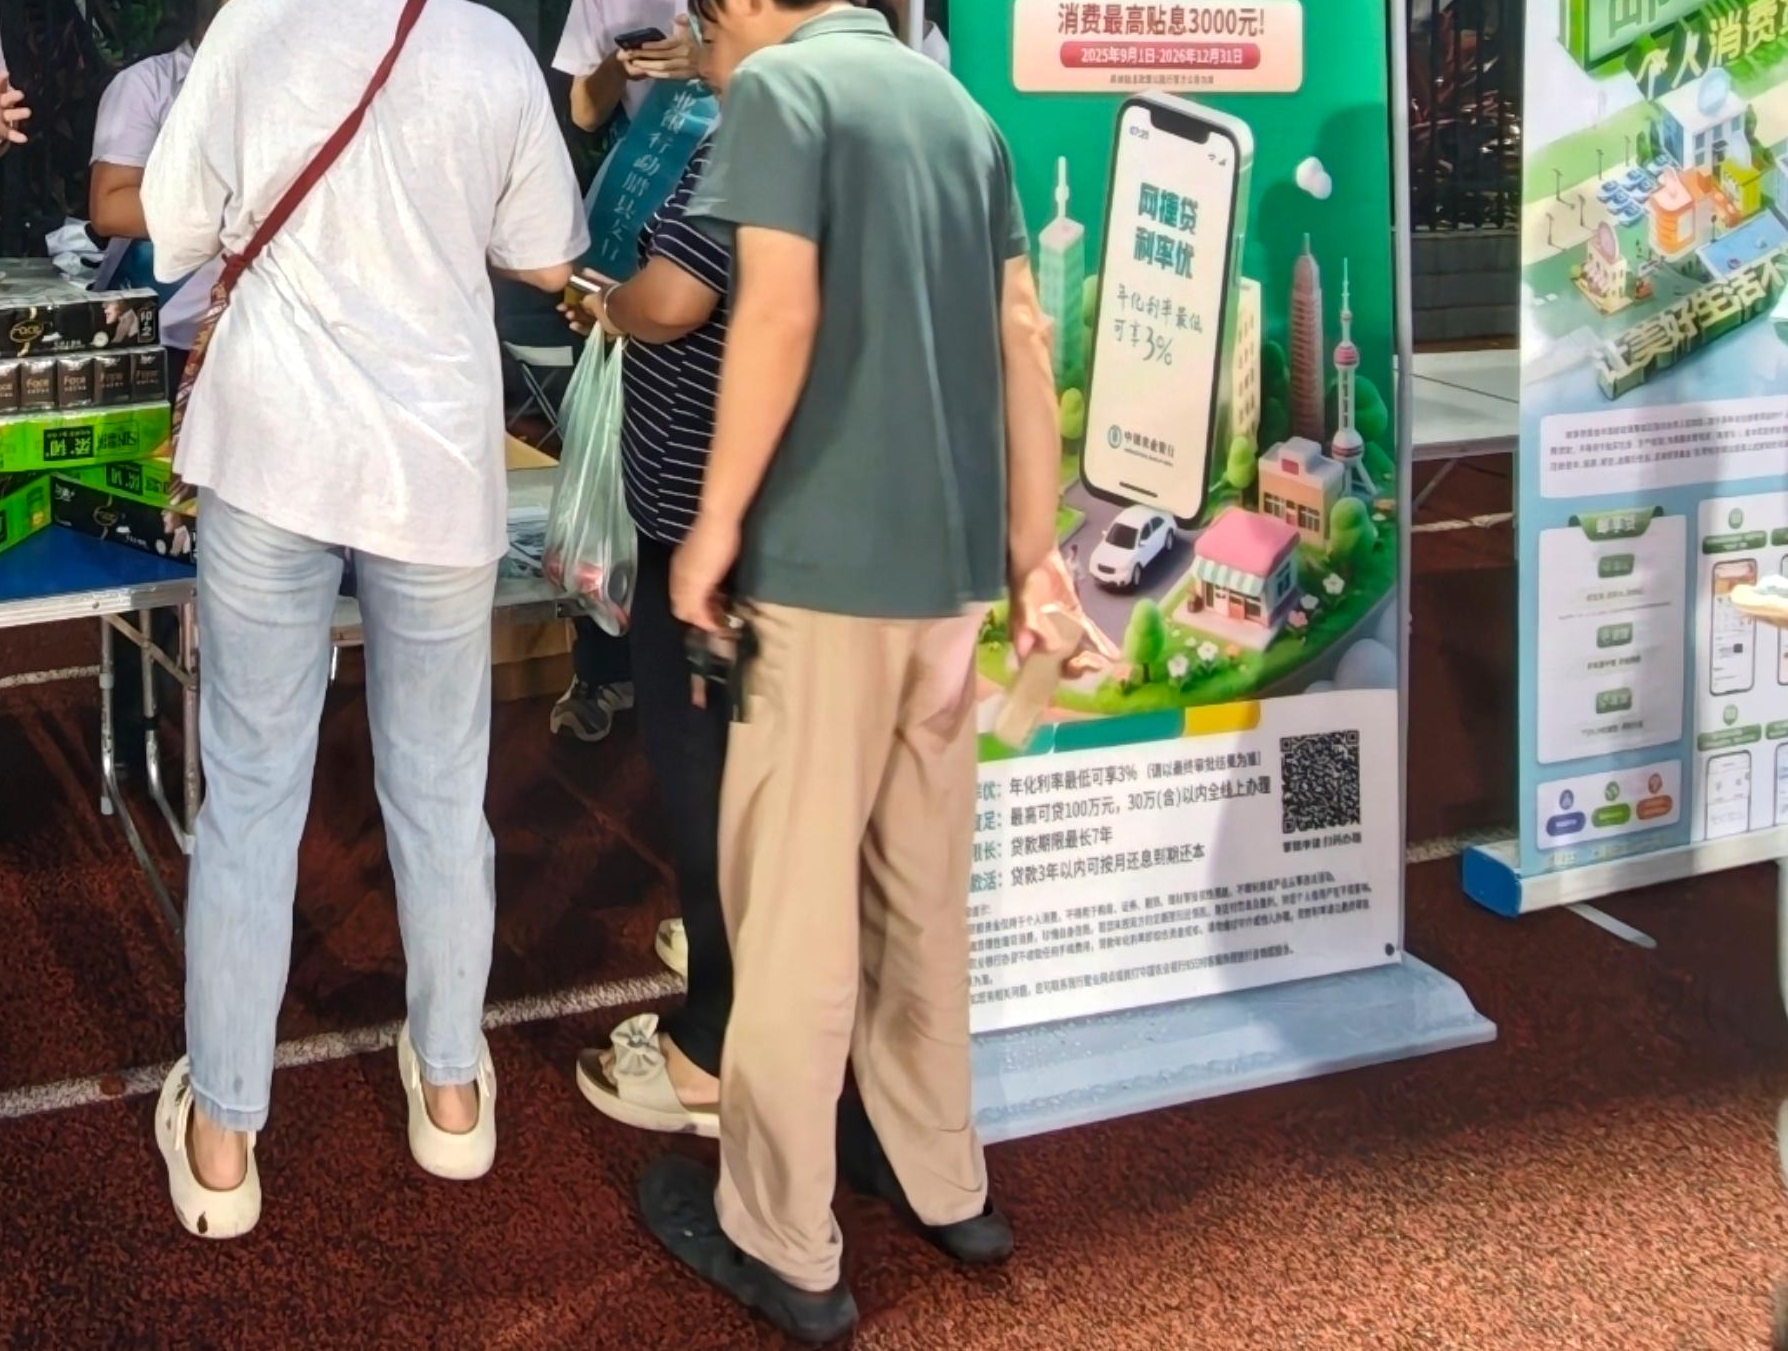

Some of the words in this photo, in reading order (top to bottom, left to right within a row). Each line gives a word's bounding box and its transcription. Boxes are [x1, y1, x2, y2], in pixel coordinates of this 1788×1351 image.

[1133, 226, 1195, 280] 利率优
[1116, 283, 1202, 333] 年化利率最低
[1114, 318, 1173, 366] 可享3%
[64, 375, 86, 385] Face
[1011, 826, 1113, 857] 贷款期限最长7年
